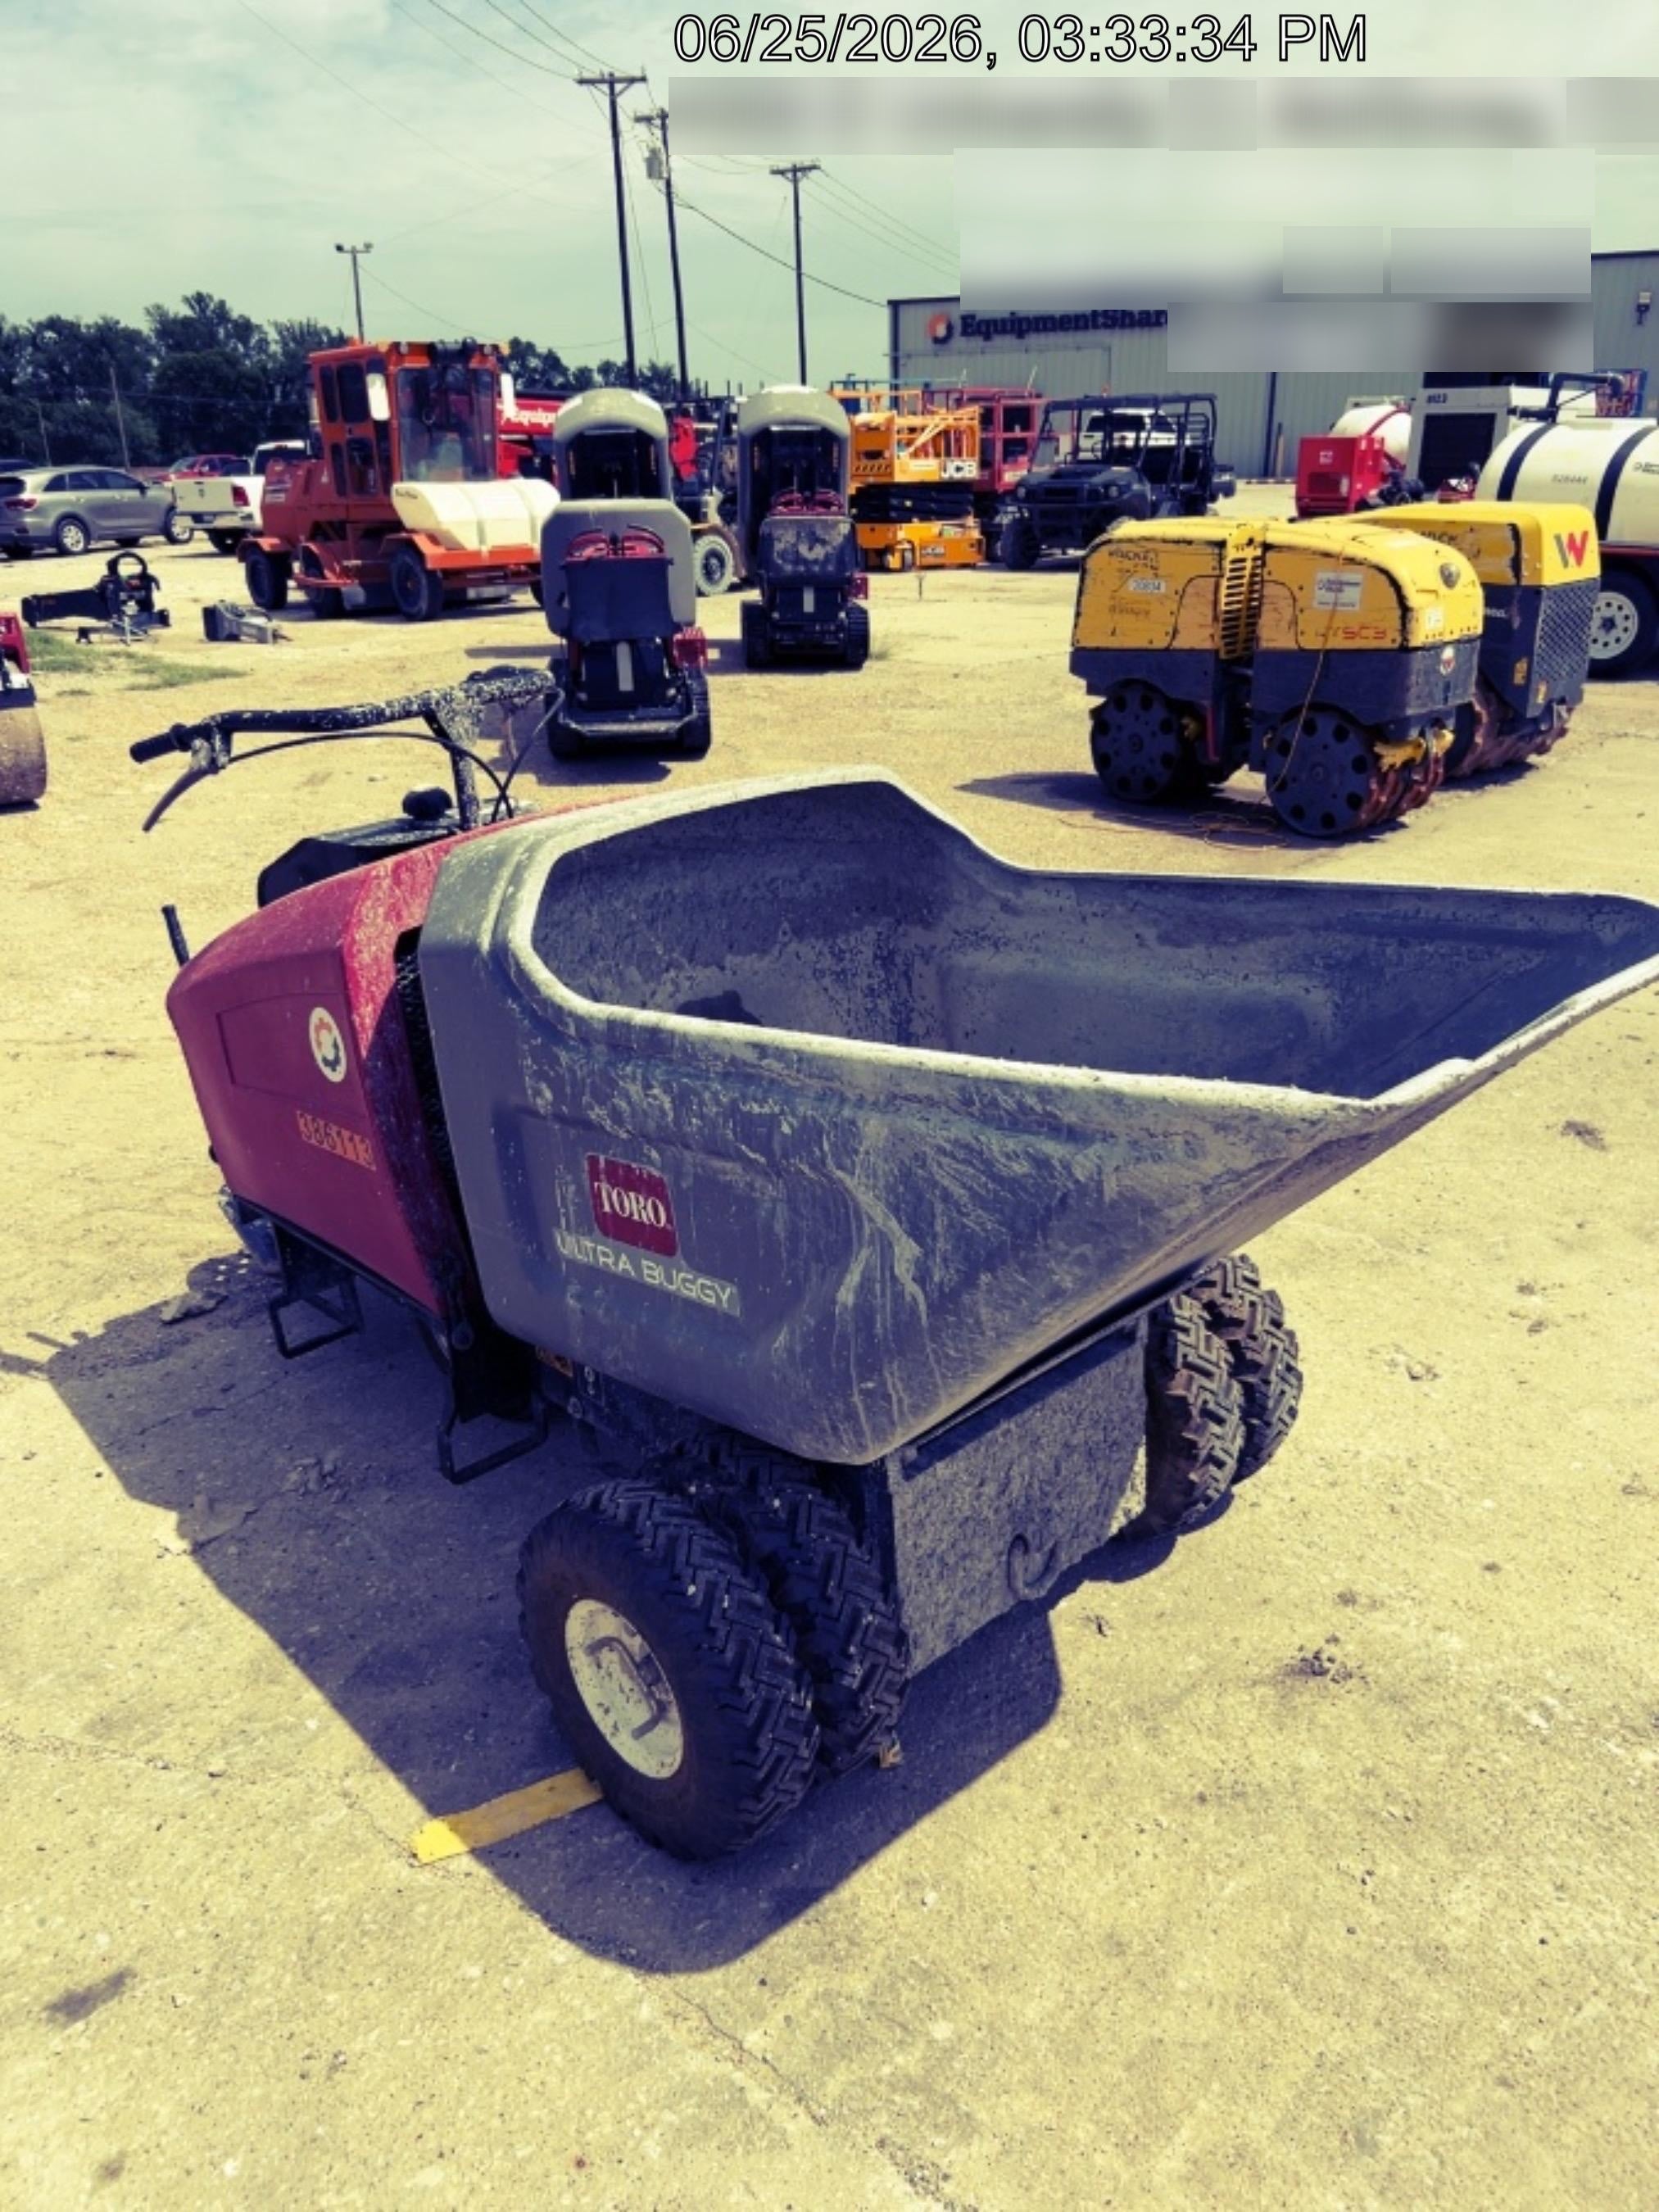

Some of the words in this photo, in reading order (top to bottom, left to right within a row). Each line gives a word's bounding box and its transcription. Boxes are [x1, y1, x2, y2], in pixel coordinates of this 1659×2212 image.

[960, 310, 1167, 341] EquipmentShar
[941, 458, 977, 478] JCB
[594, 1181, 667, 1228] TORO
[555, 1231, 636, 1277] ULTRA
[641, 1258, 732, 1308] BUGGY
